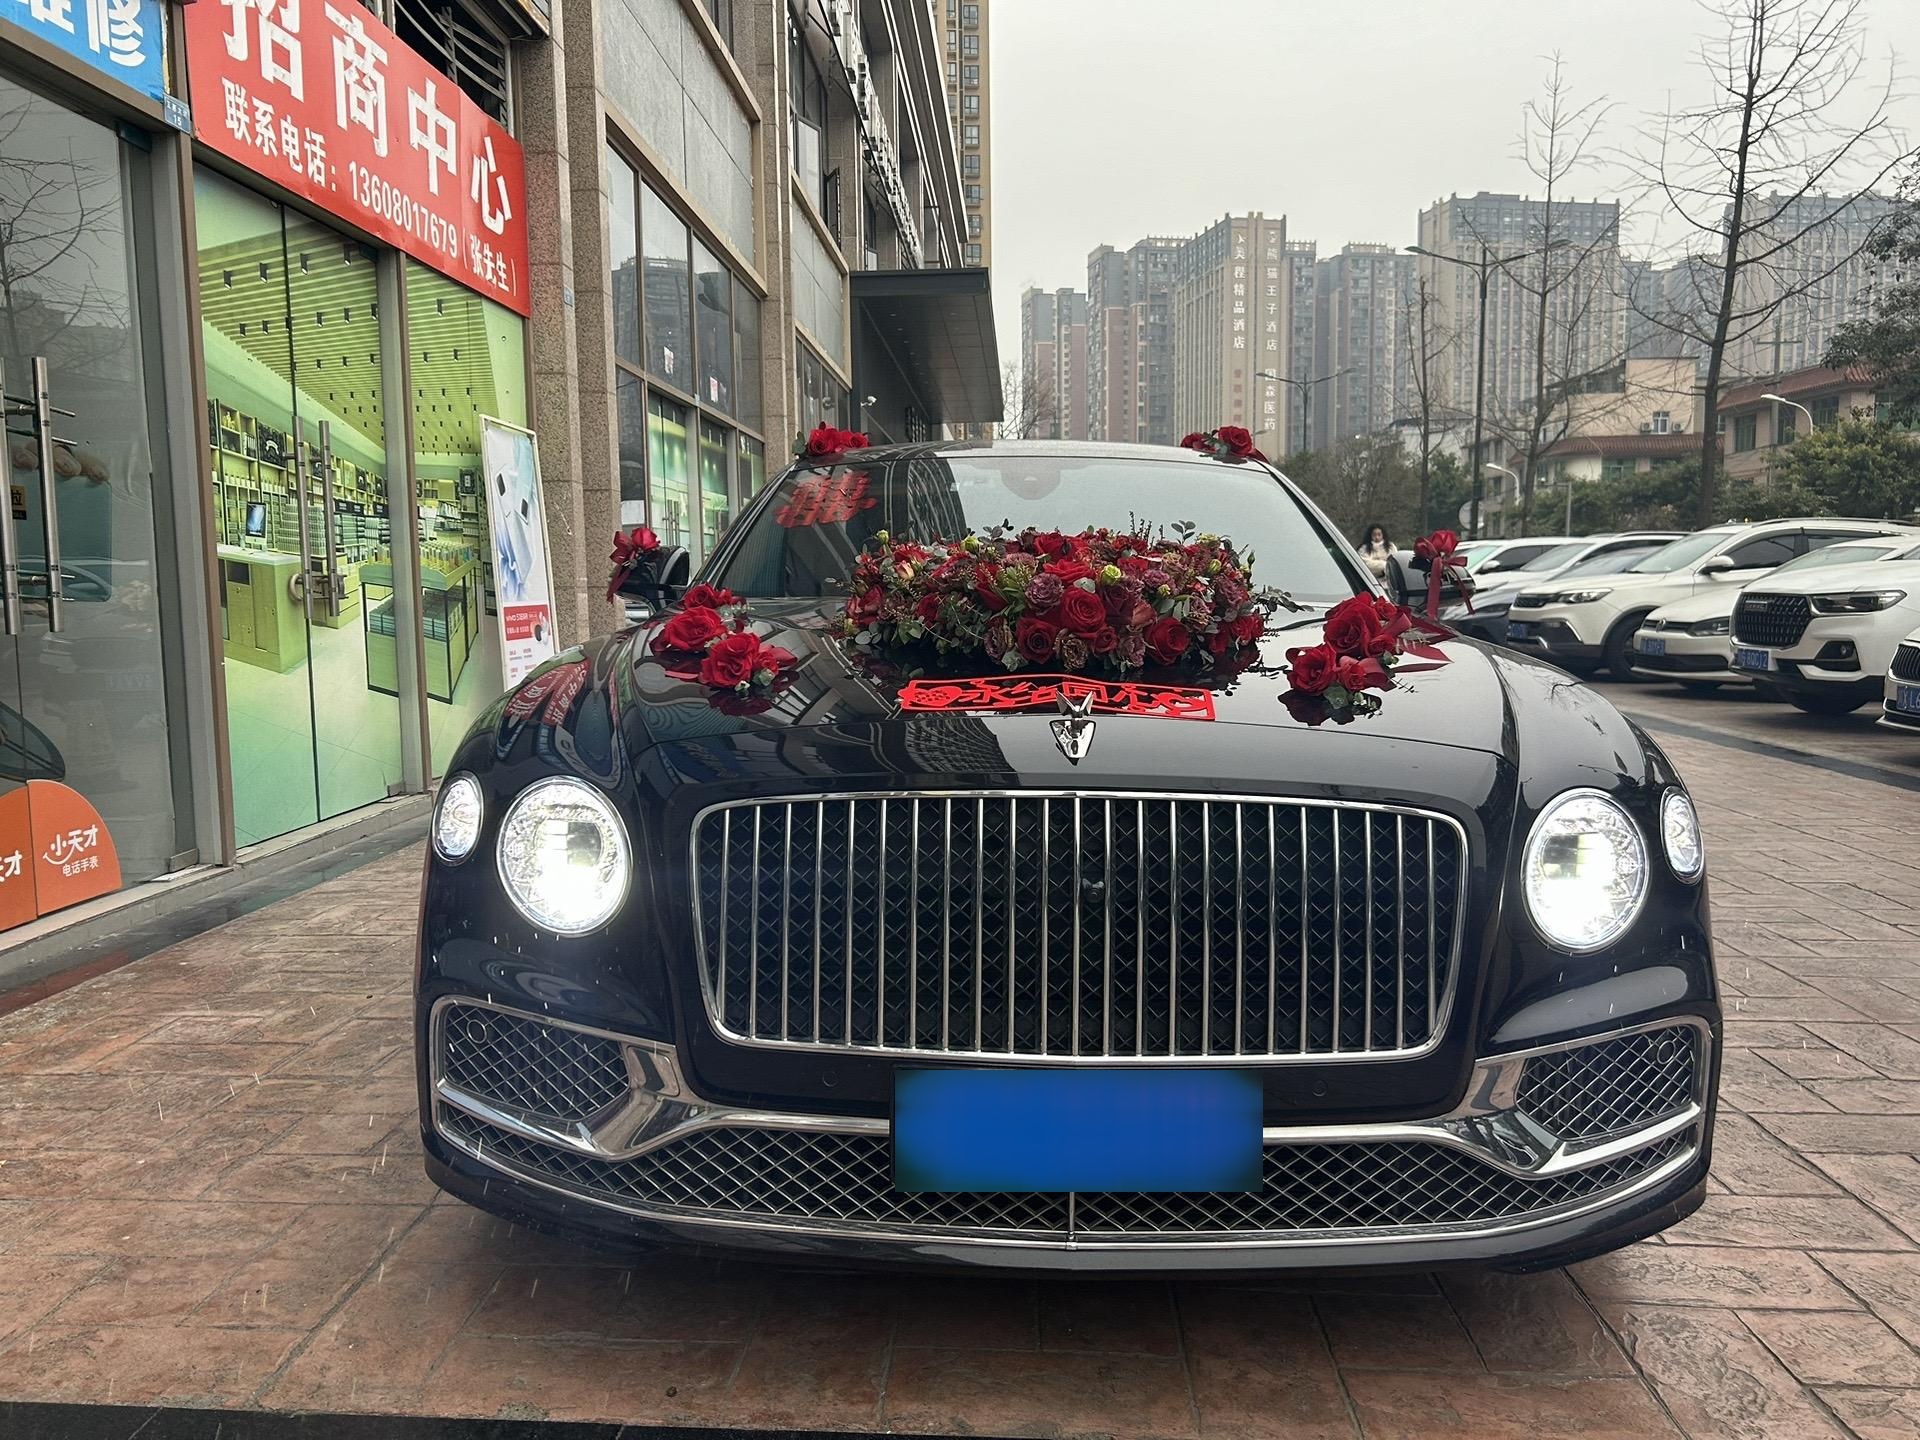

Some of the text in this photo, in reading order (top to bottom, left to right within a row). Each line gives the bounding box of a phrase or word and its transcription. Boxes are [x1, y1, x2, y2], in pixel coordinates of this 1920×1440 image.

[220, 0, 513, 236] 招商中心
[44, 824, 98, 864] 小天才
[62, 855, 99, 877] 电话手表
